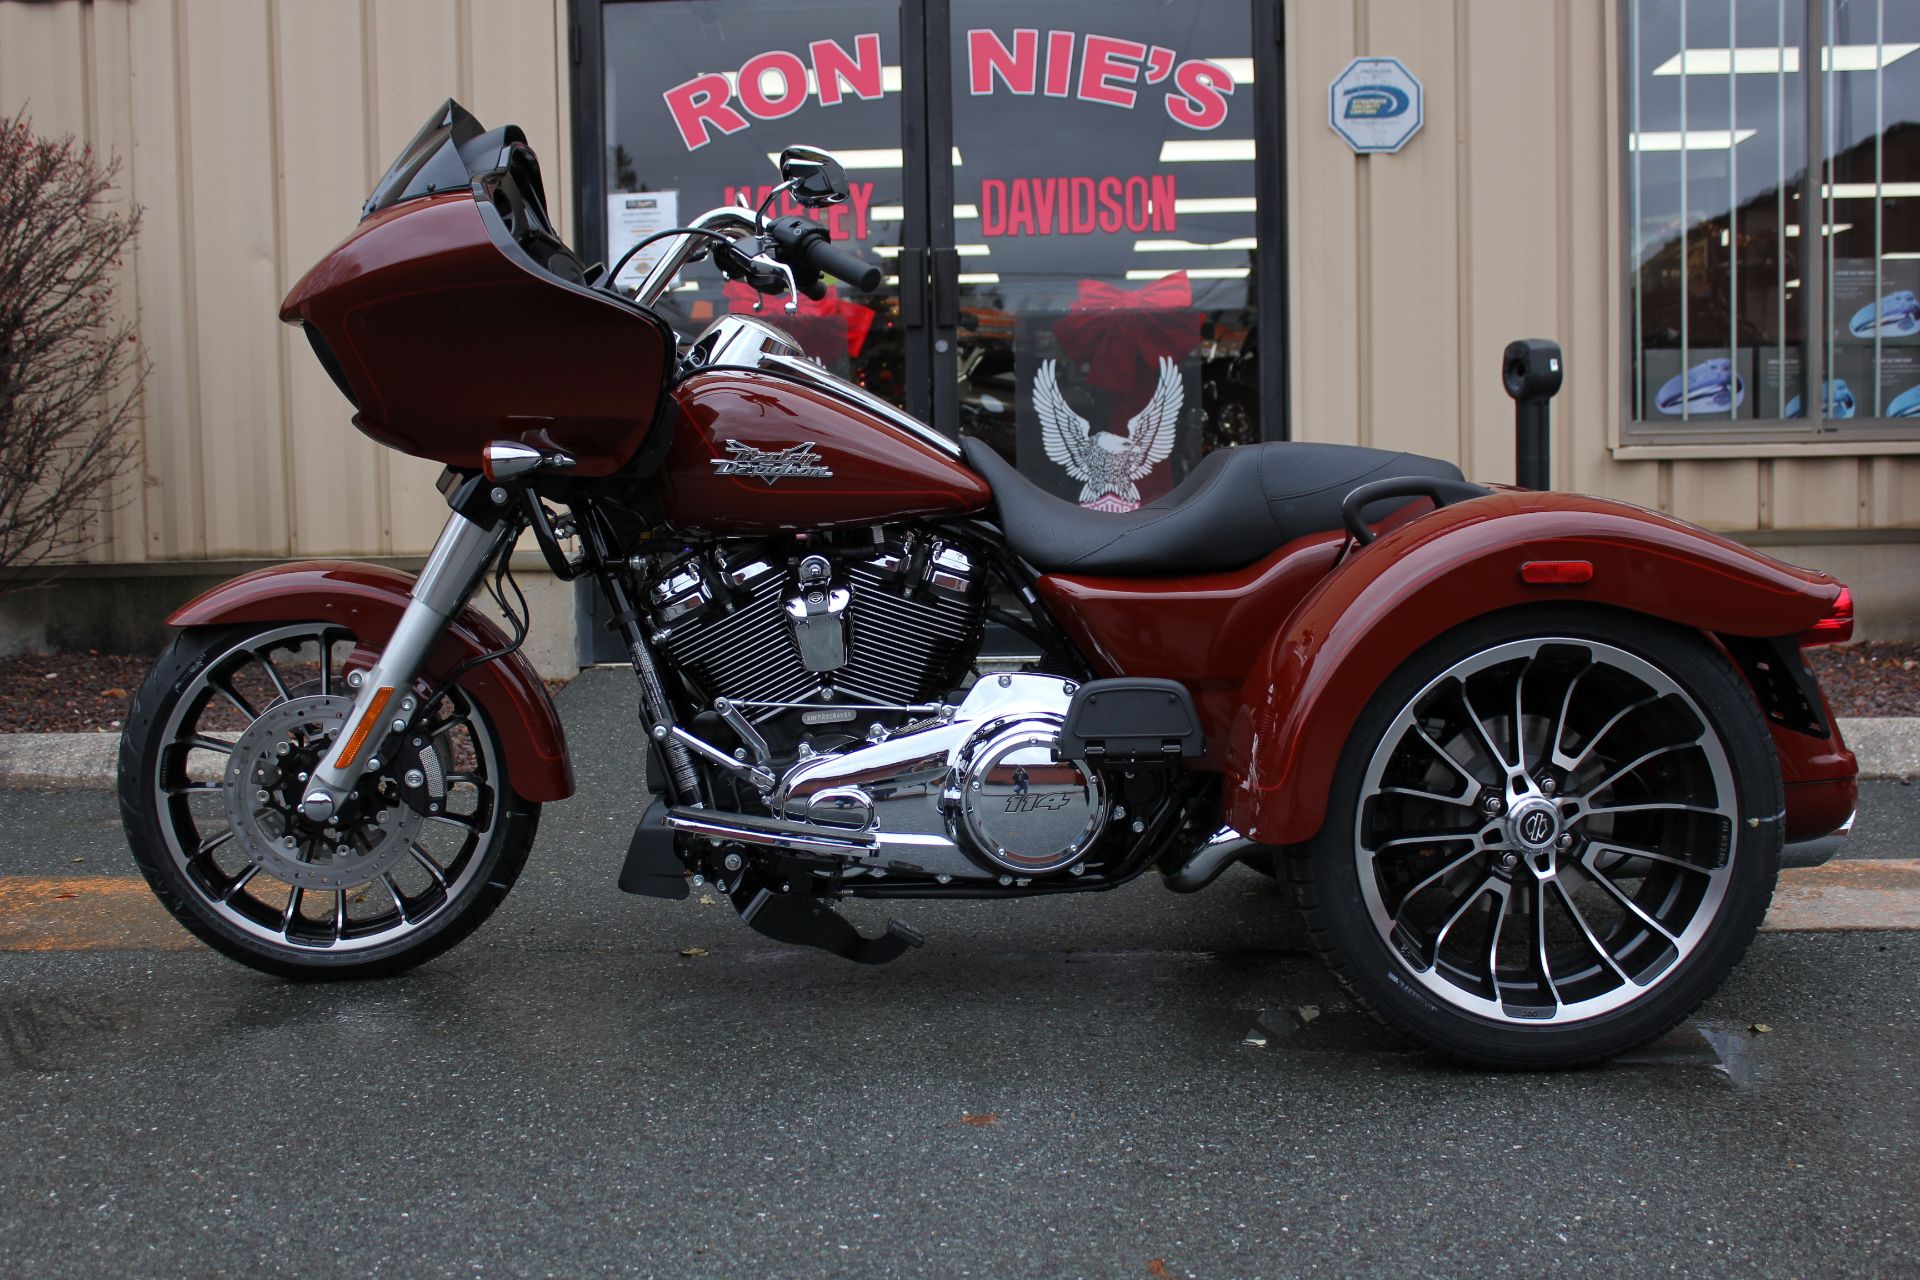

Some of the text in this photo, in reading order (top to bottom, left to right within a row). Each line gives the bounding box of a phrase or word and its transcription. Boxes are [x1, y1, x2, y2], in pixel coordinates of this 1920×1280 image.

[663, 28, 1235, 152] RON NIE'S
[981, 174, 1177, 238] DAVIDSON
[710, 458, 834, 477] Davidson
[1005, 792, 1071, 813] 114
